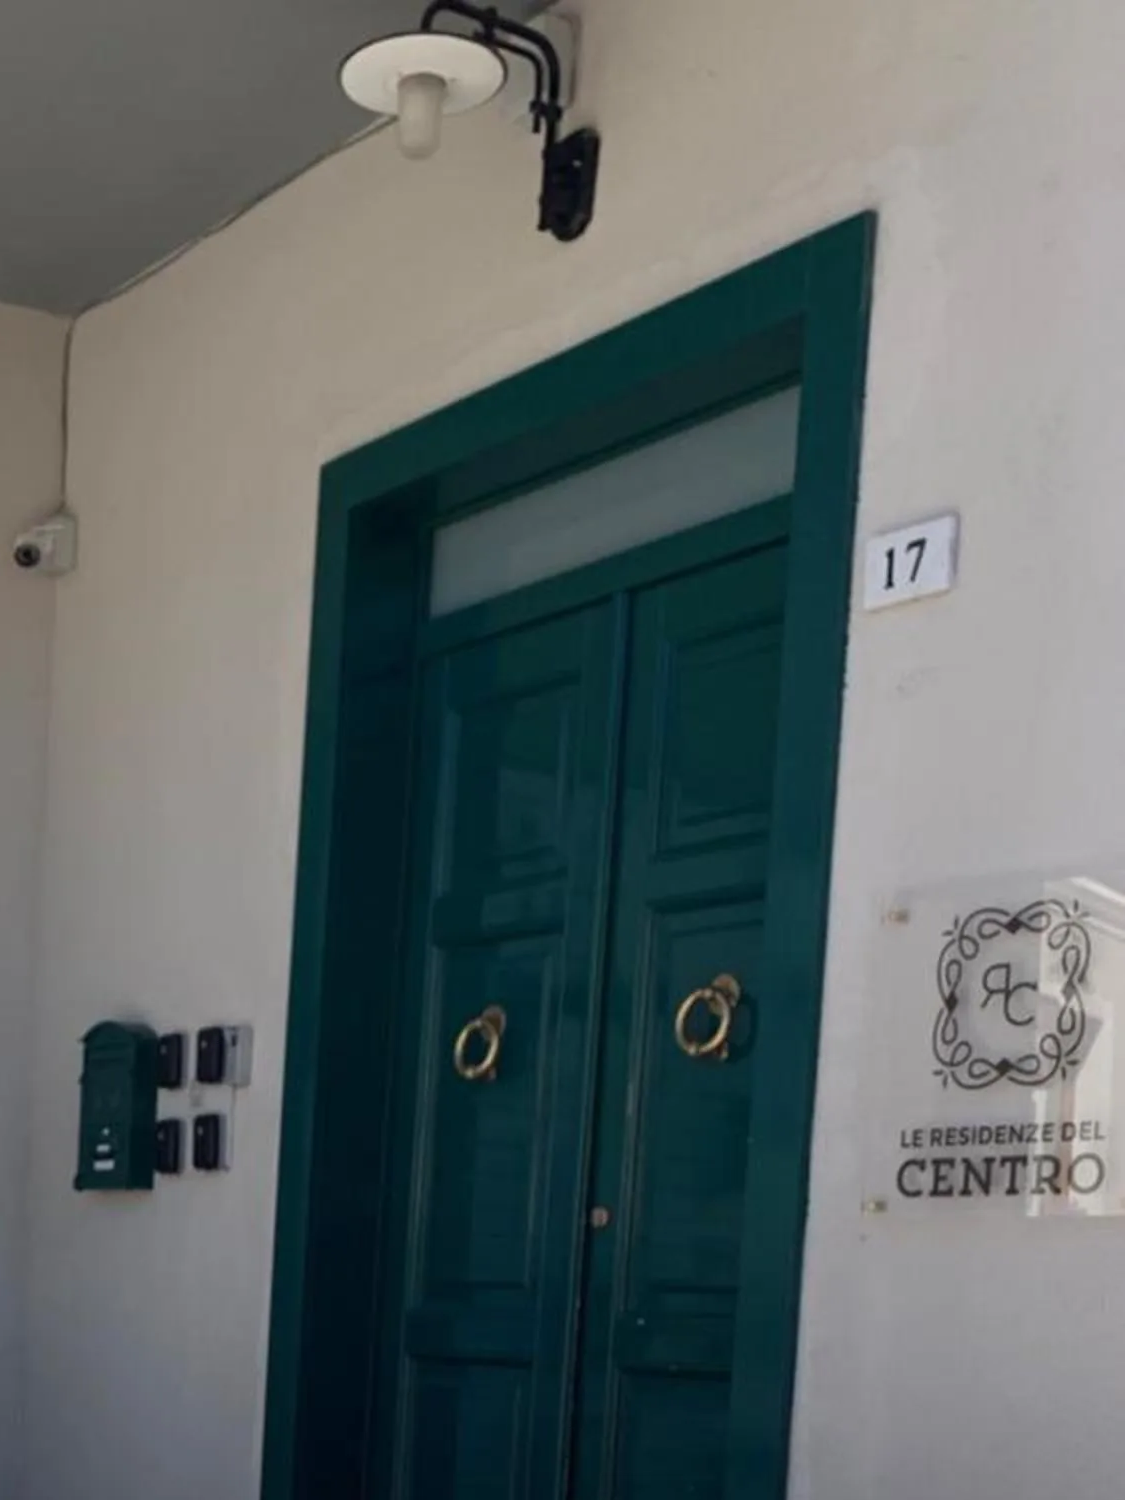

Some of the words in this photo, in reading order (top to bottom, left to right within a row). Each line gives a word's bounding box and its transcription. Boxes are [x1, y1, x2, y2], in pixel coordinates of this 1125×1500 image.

[883, 537, 927, 591] 17
[900, 1129, 924, 1149] LE
[929, 1123, 1055, 1147] RESIDENZE
[1060, 1121, 1106, 1142] DEL
[896, 1153, 1106, 1198] CENTRO
